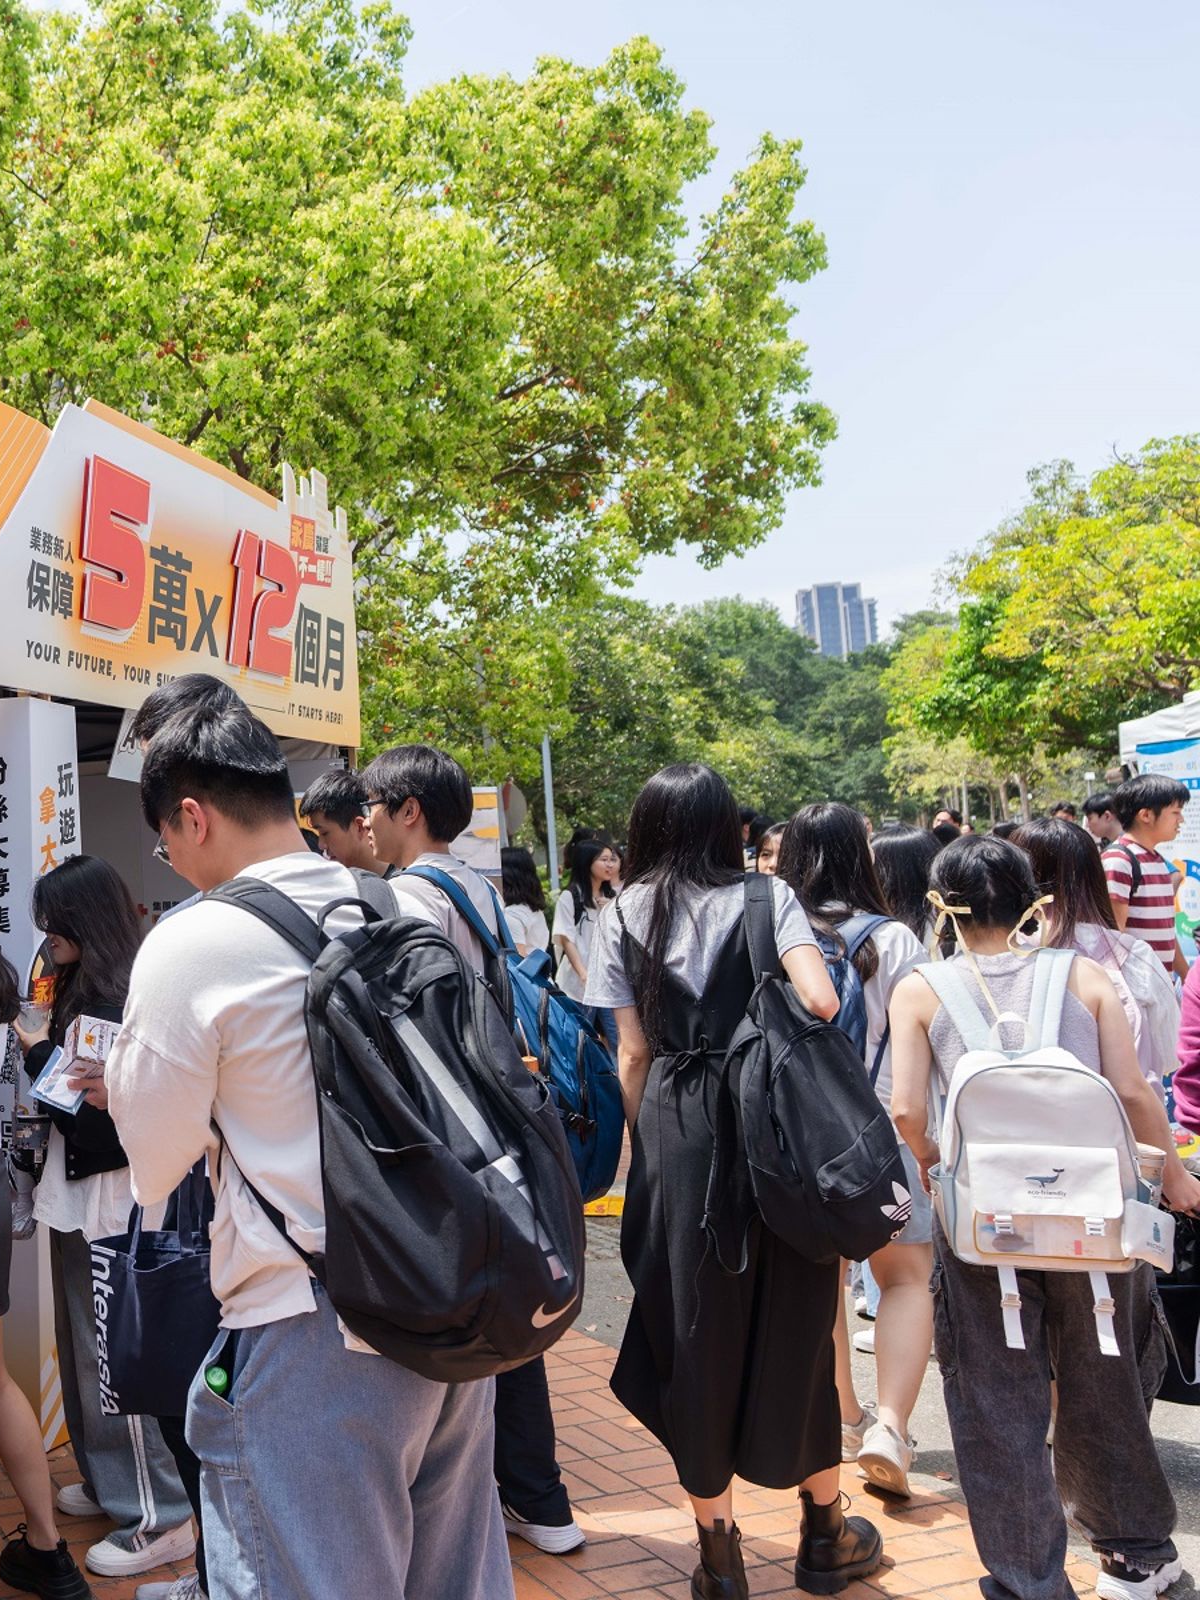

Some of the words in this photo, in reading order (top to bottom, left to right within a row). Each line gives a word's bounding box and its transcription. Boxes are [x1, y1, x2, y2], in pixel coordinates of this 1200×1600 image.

[29, 526, 75, 565] 業務新人
[26, 559, 75, 621] 保障
[26, 639, 61, 665] YOUR
[67, 650, 117, 681] FUTURE,
[123, 663, 151, 690] YOUR
[298, 705, 323, 721] STARTS
[57, 762, 77, 863] 玩遊
[90, 1242, 121, 1416] Interasia
